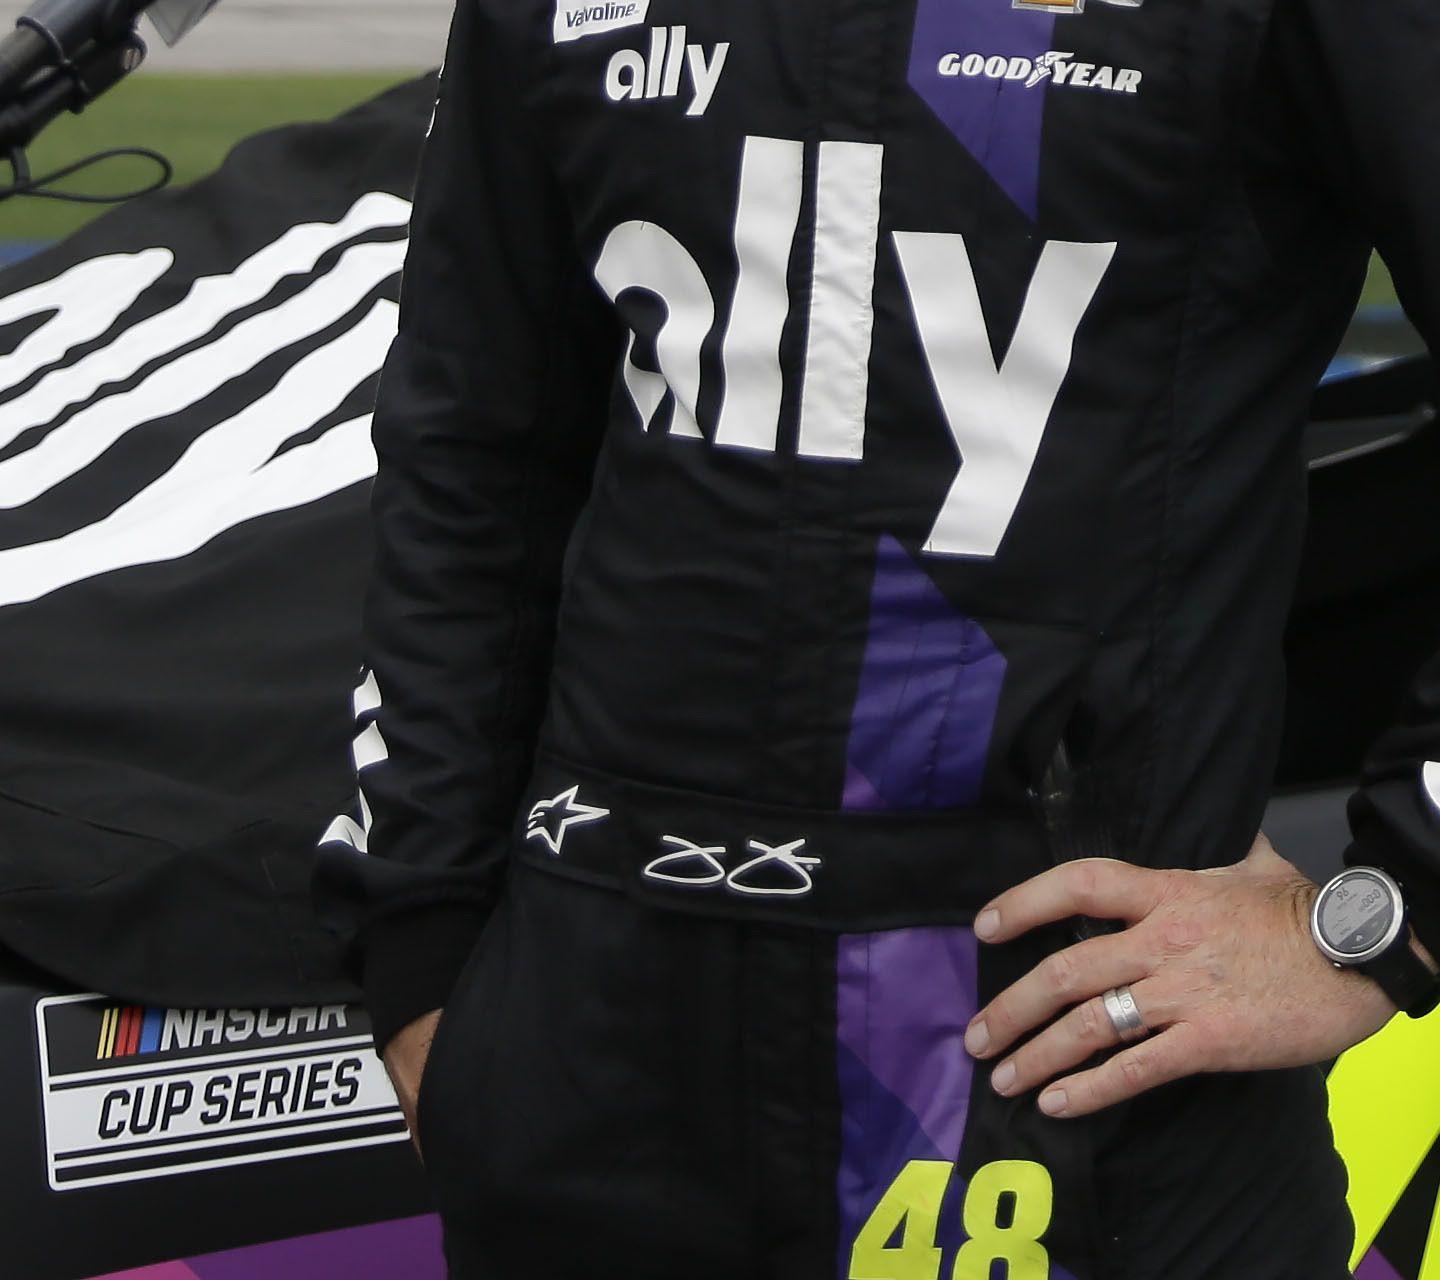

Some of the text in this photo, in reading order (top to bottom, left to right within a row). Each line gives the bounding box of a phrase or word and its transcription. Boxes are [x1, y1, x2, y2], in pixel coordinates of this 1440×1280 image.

[605, 25, 730, 116] ally
[593, 134, 1118, 558] ally
[97, 1057, 364, 1140] CUP SERIES
[848, 1159, 1054, 1280] 48
